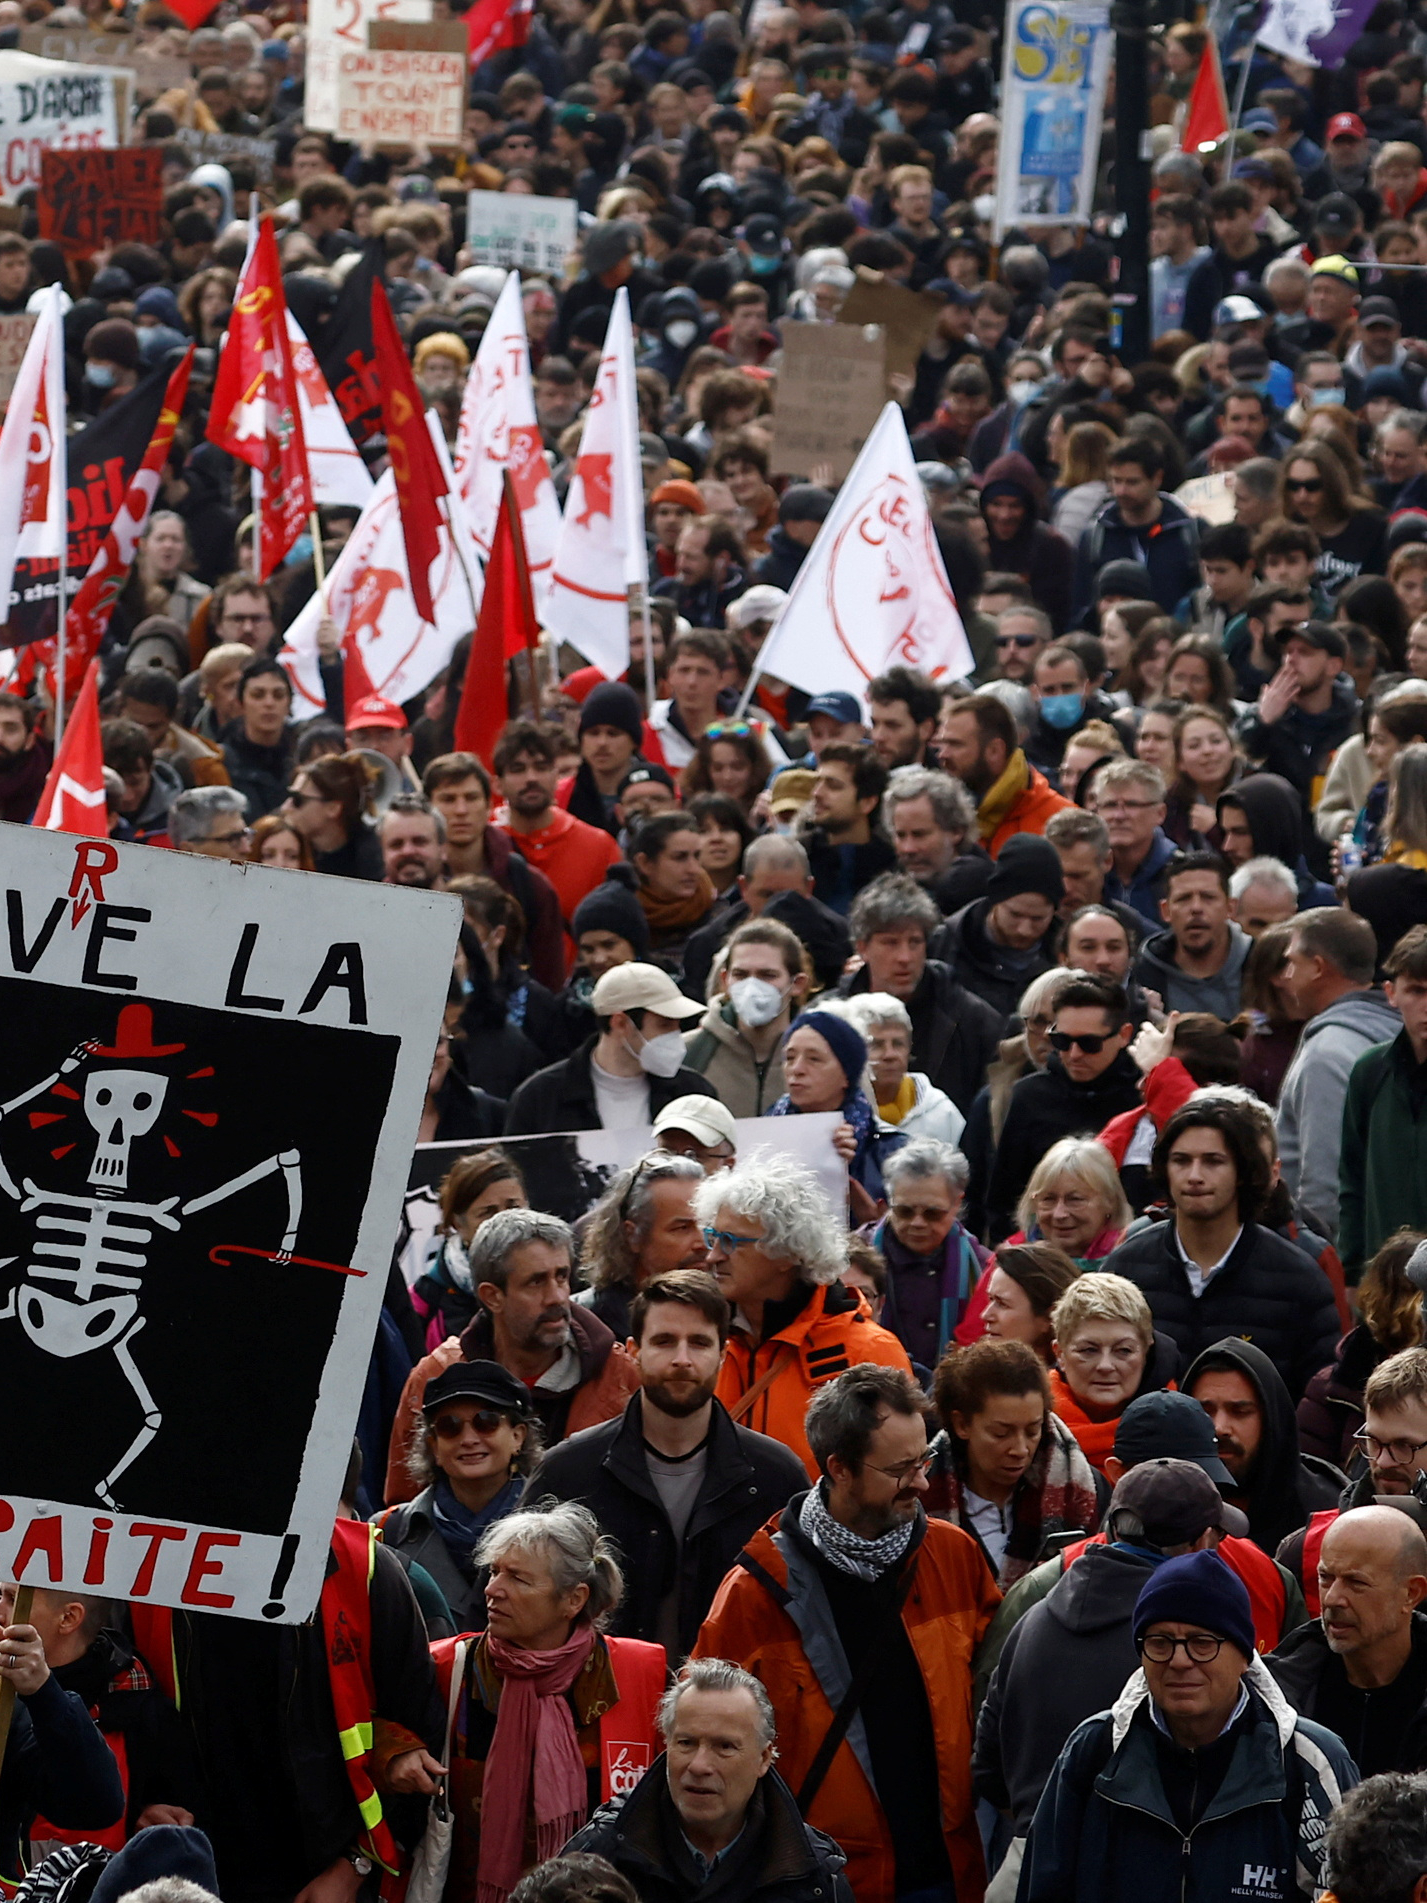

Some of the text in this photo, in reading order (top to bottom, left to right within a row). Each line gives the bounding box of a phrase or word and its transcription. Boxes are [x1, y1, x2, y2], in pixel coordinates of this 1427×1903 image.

[69, 841, 119, 903] R
[224, 922, 369, 1025] LA
[1231, 1887, 1284, 1900] HELLY HANSEN
[1243, 1863, 1278, 1889] HH
